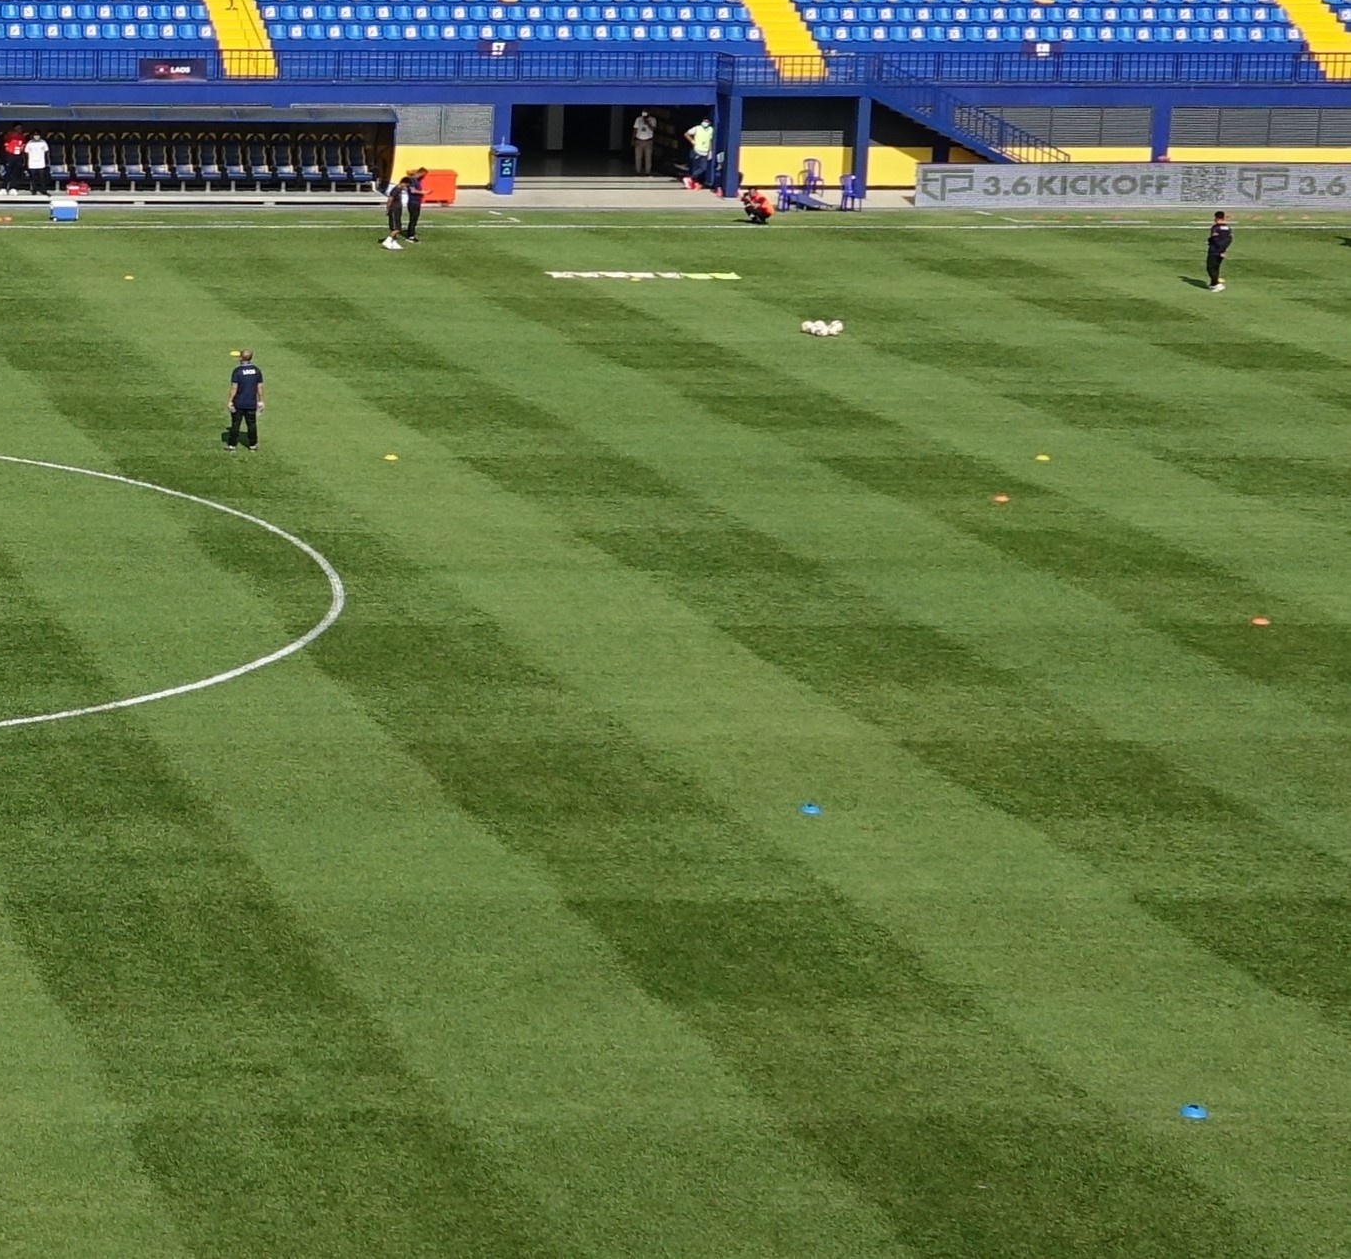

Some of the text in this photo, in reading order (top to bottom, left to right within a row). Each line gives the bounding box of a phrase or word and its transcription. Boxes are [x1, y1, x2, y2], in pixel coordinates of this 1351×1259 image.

[170, 66, 191, 74] LAOS
[983, 174, 1171, 196] 3.6 KICKOFF
[1299, 175, 1346, 196] 3.6
